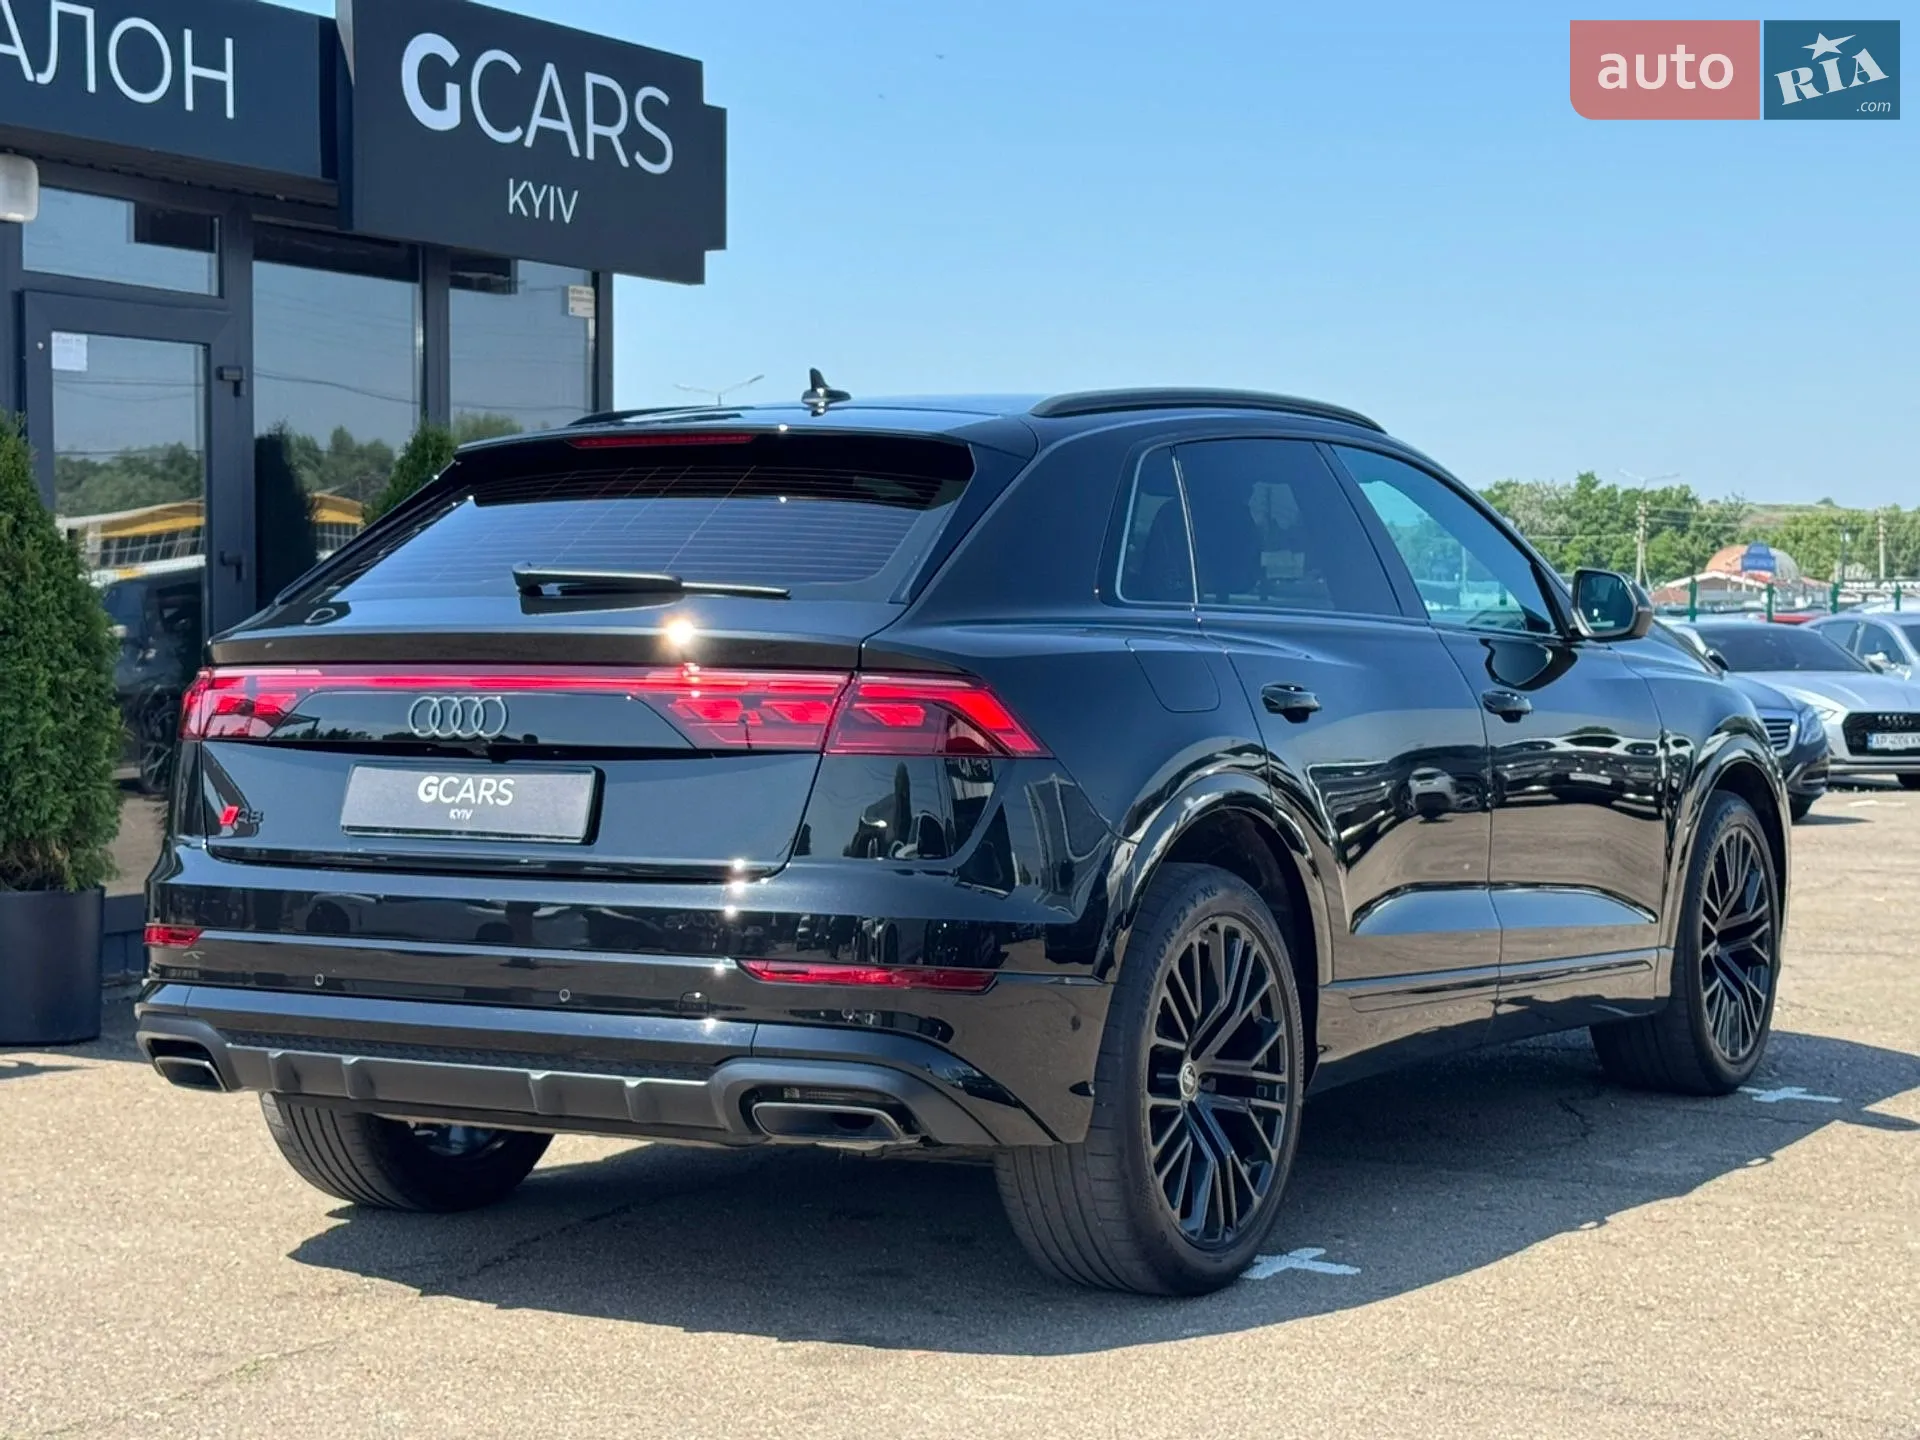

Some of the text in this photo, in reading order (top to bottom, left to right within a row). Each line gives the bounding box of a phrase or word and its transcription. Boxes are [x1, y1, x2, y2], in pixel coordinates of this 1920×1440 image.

[401, 32, 674, 174] GCARS
[508, 178, 579, 223] KYIV
[417, 775, 515, 806] GCARS
[449, 808, 473, 820] KYIV
